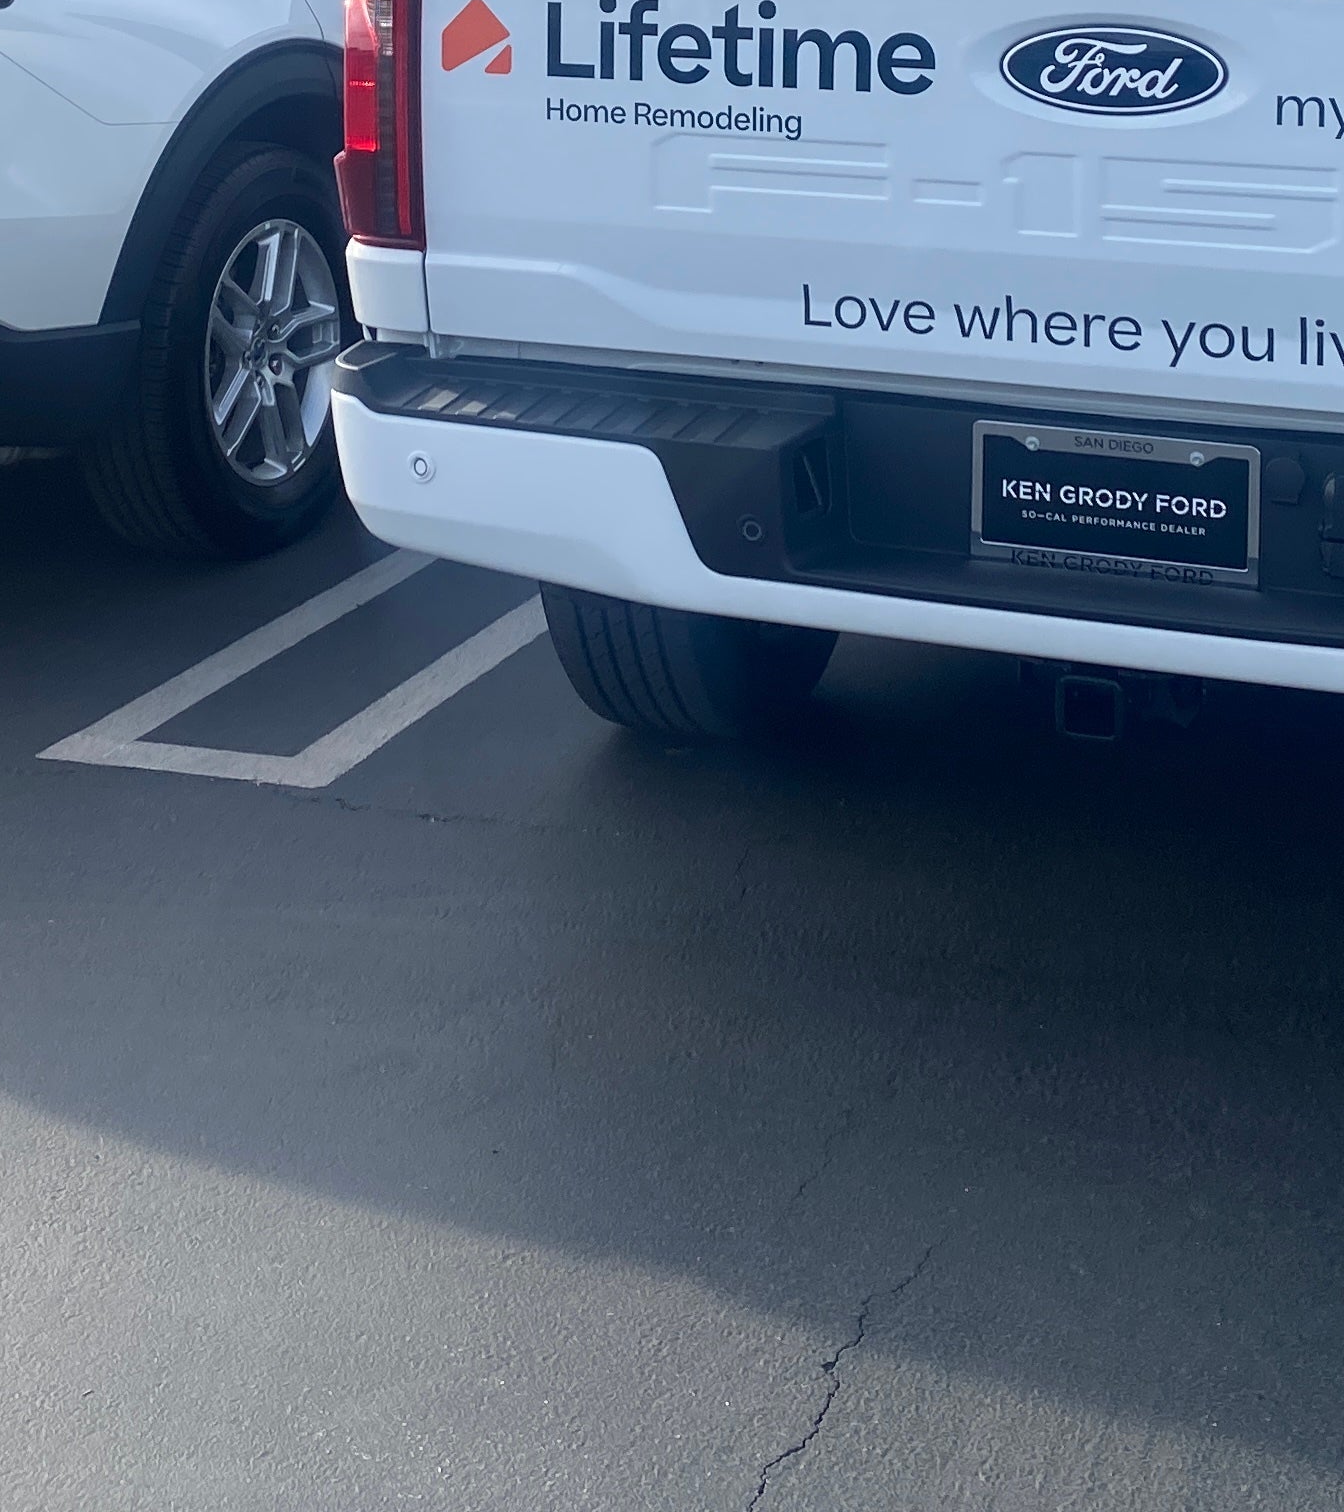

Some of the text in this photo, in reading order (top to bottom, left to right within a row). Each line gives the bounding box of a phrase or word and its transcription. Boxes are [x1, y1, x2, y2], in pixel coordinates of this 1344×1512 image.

[1038, 37, 1182, 99] Ford
[546, 97, 802, 141] Home Remodeling
[802, 283, 936, 335] Love
[953, 294, 1142, 351] where
[1161, 319, 1275, 368] you
[1073, 436, 1154, 454] SAN DIEGO
[1002, 479, 1227, 518] KEN GRODY FORD
[1021, 509, 1206, 536] SO-CAL PERFORMANCE DEALER
[1010, 549, 1214, 586] KEN GRODY FORD
